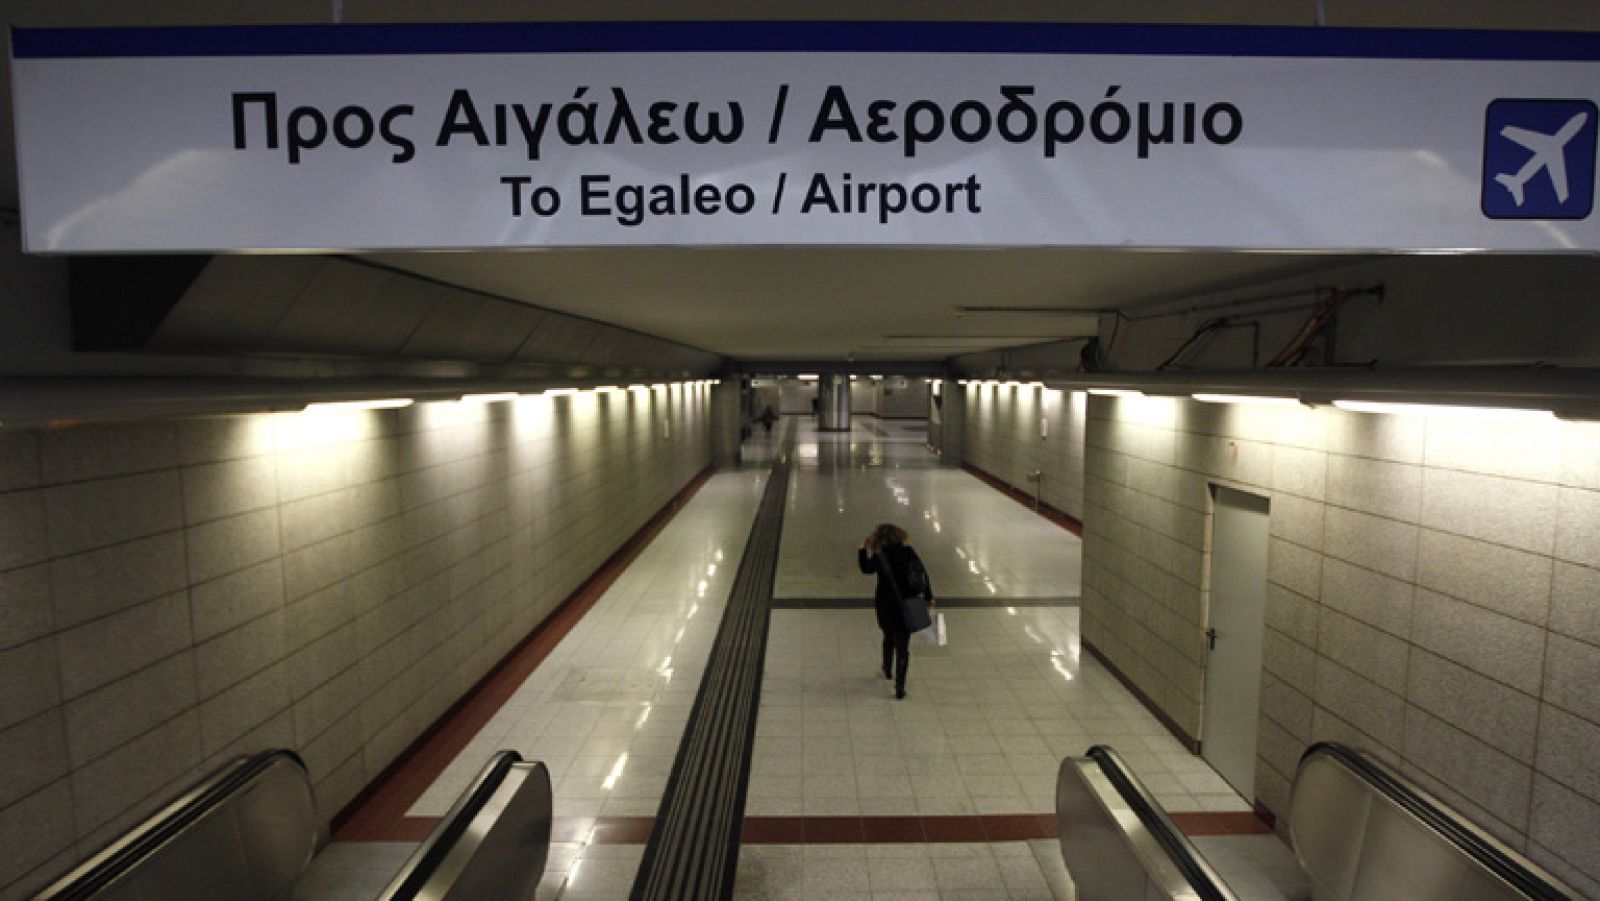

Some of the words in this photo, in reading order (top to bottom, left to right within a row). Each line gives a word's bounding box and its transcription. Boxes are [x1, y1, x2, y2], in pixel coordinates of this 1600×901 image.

[231, 91, 416, 164] Προς
[435, 85, 745, 161] Αιγάλεω
[768, 84, 790, 144] /
[807, 84, 1243, 158] Αεροδρόμιο
[500, 176, 560, 216] To
[580, 173, 755, 225] Egaleo
[772, 172, 787, 214] /
[801, 172, 982, 223] Airport
